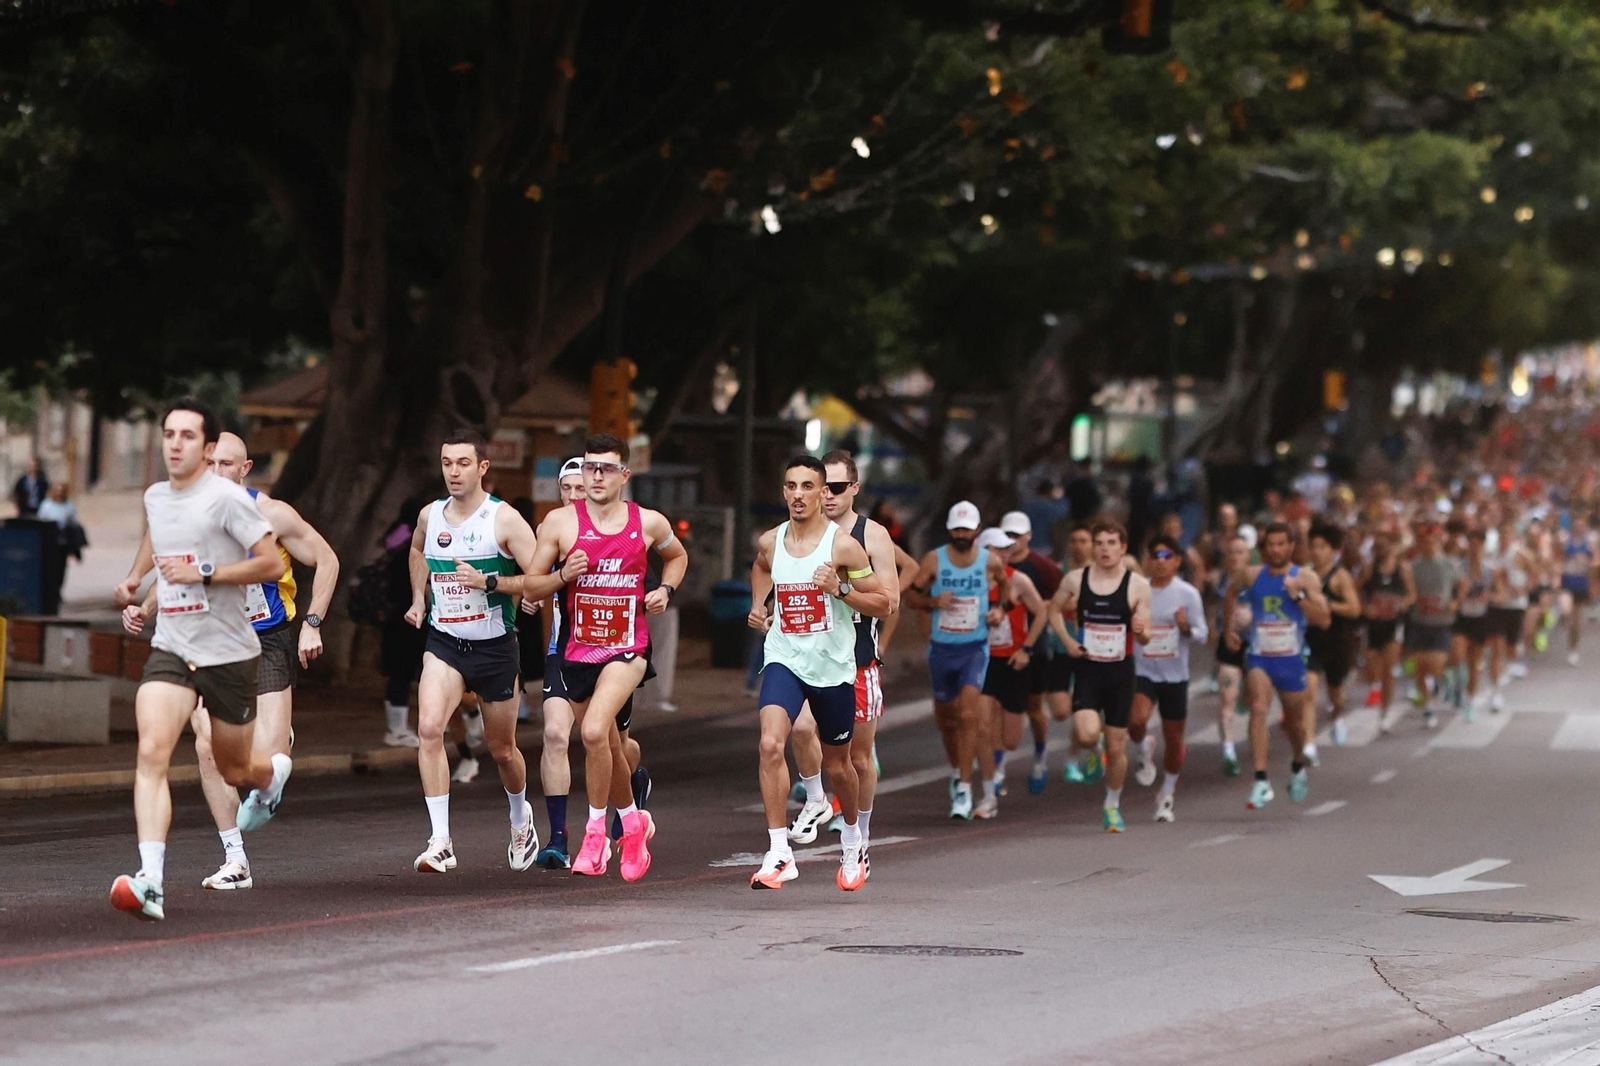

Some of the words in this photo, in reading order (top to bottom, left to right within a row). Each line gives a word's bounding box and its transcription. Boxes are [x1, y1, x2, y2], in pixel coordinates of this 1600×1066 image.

[597, 558, 623, 572] PEAK
[576, 574, 639, 588] PERFORMANCE
[942, 575, 981, 590] nerja
[441, 585, 471, 596] 14625
[590, 597, 627, 607] GENERALI
[788, 595, 808, 606] 252
[592, 609, 613, 620] 316
